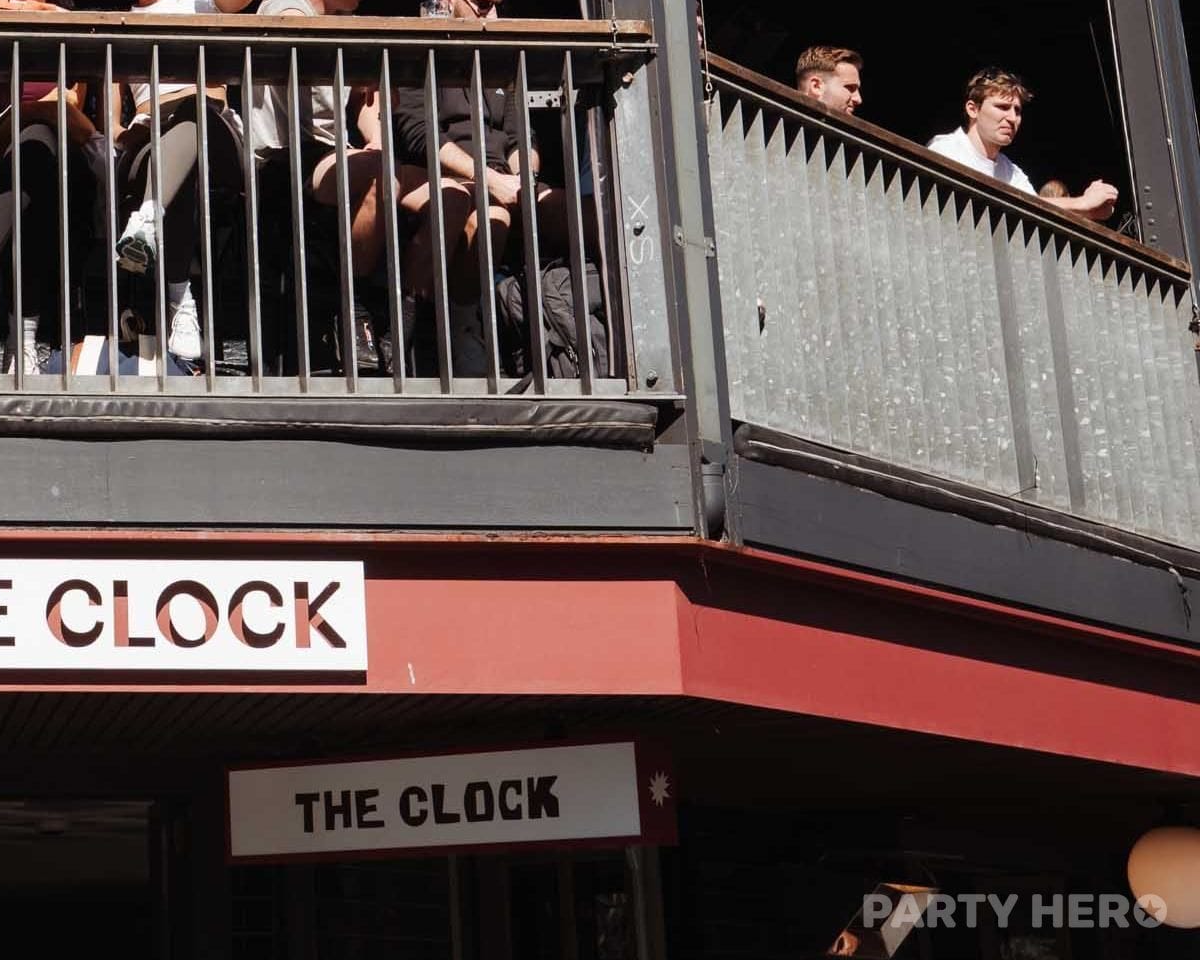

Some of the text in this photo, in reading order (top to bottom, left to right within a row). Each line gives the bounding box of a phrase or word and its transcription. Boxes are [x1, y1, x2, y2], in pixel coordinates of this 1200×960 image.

[45, 579, 347, 649] CLOCK
[294, 775, 561, 833] THE CLOCK
